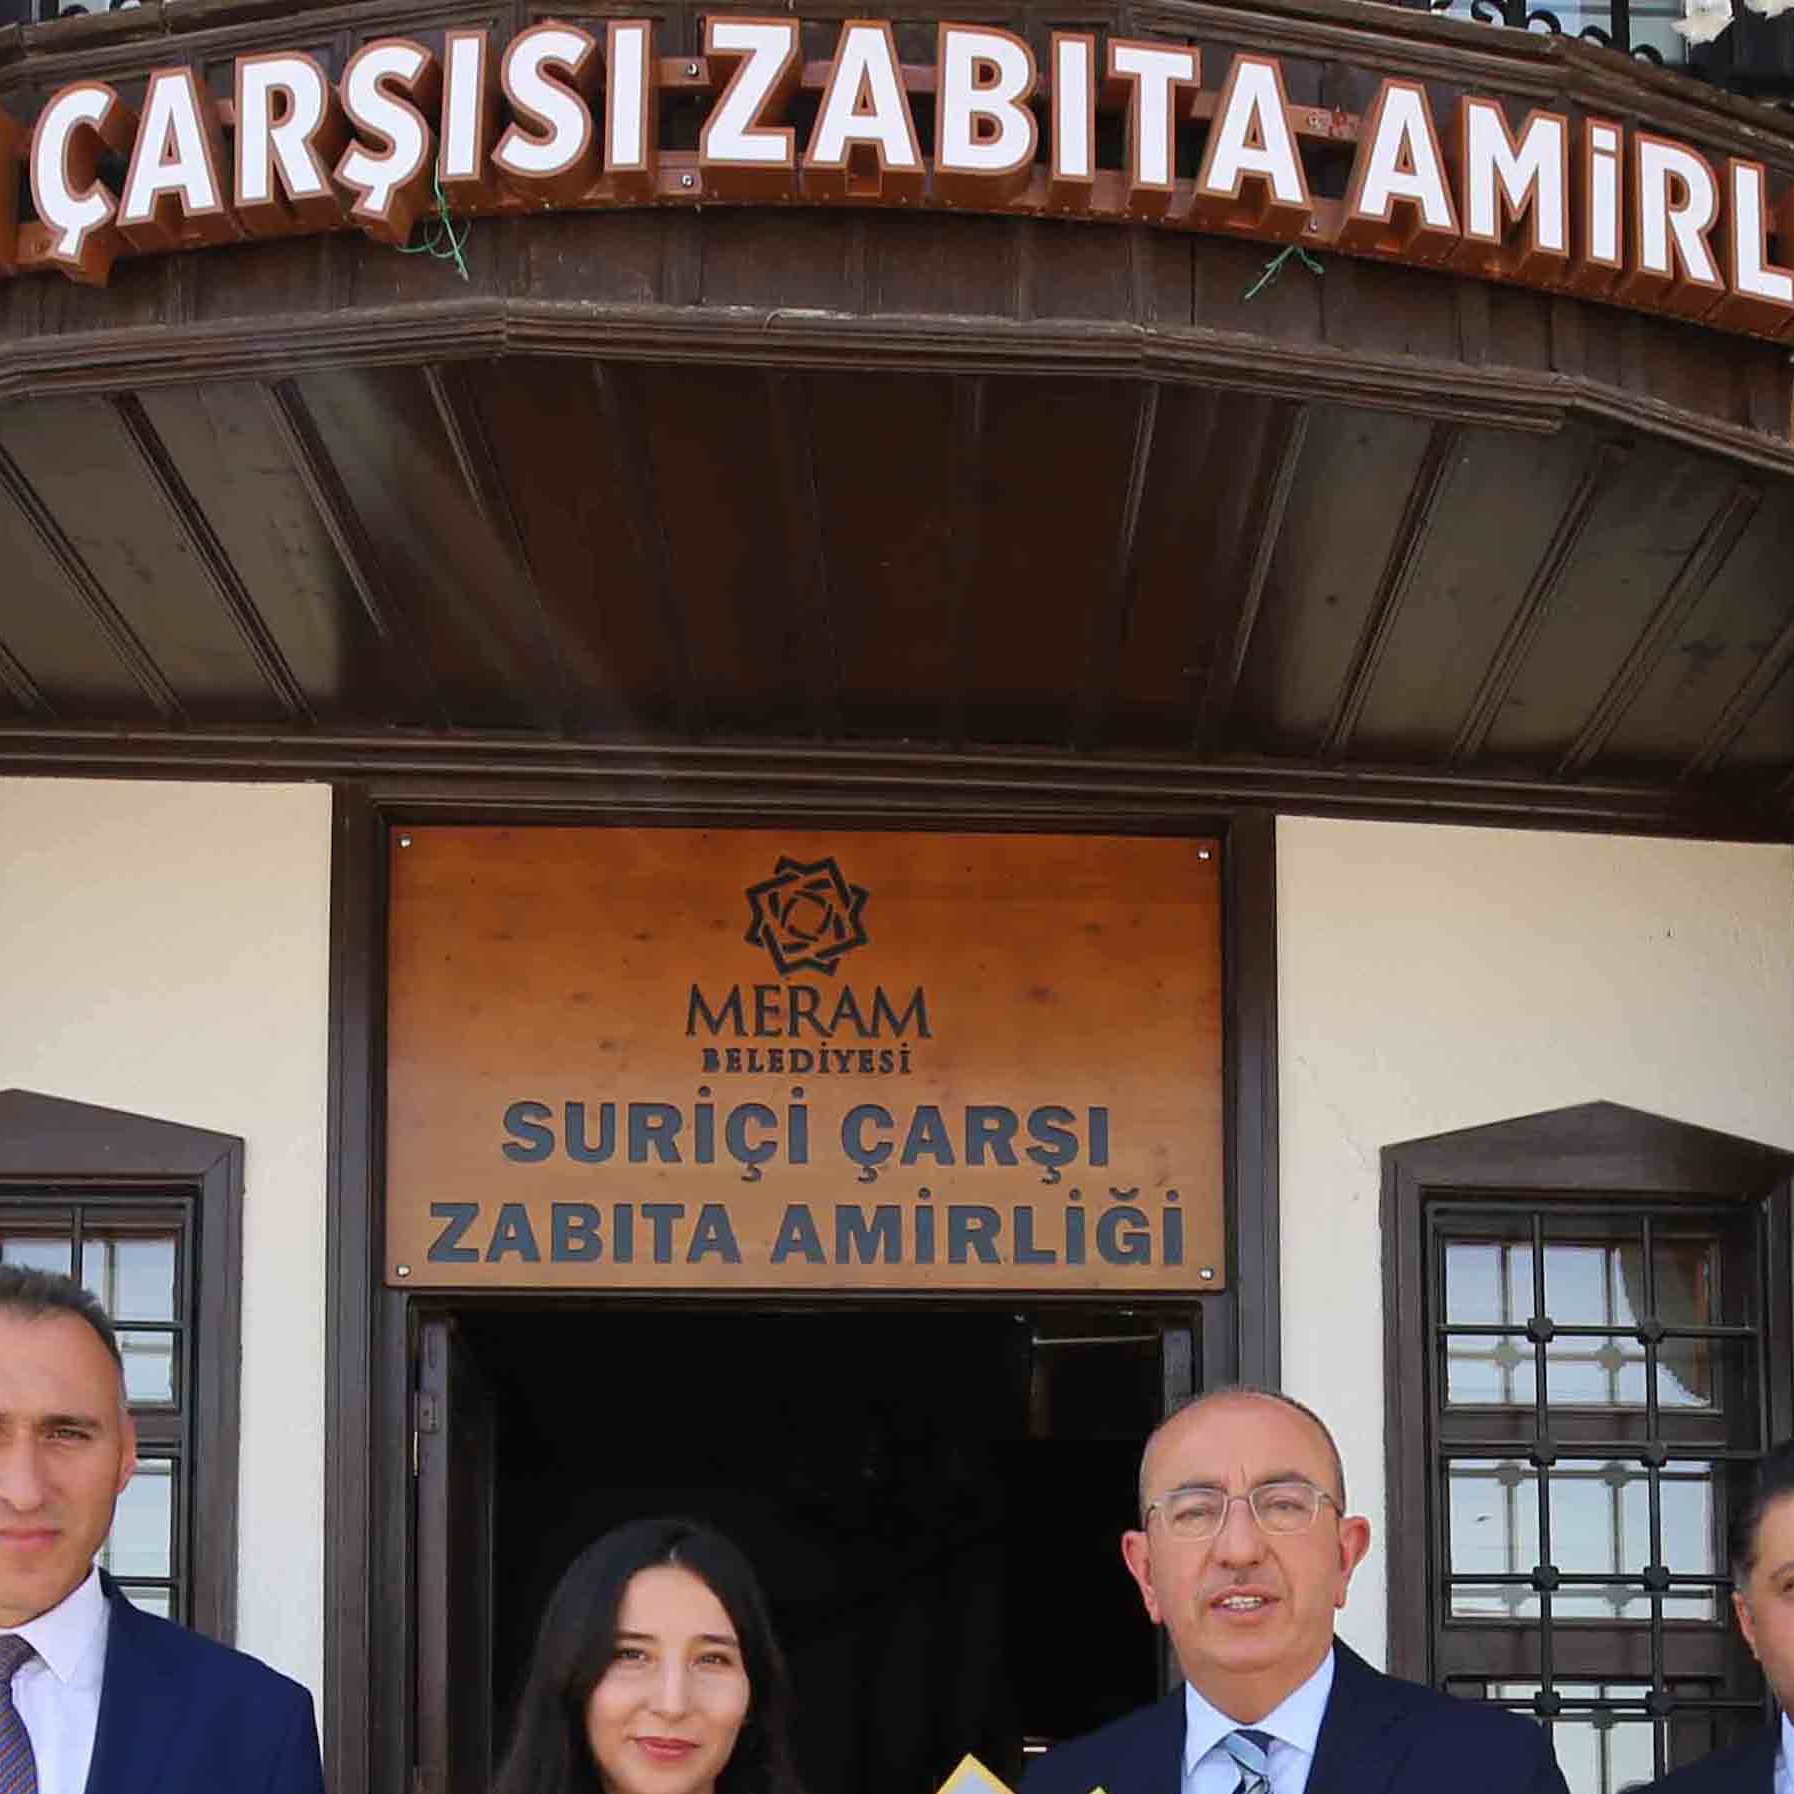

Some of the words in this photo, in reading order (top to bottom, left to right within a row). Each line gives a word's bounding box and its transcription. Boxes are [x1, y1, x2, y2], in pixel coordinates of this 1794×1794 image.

[30, 18, 655, 262] ÇARŞISI
[701, 18, 1311, 212] ZABITA
[685, 983, 932, 1039] MERAM
[701, 1041, 911, 1075] BELEDİYESİ
[501, 1086, 806, 1183] SURİÇİ
[841, 1105, 1109, 1185] ÇARŞI
[427, 1202, 738, 1264] ZABITA
[771, 1187, 1184, 1267] AMİRLİĞİ
